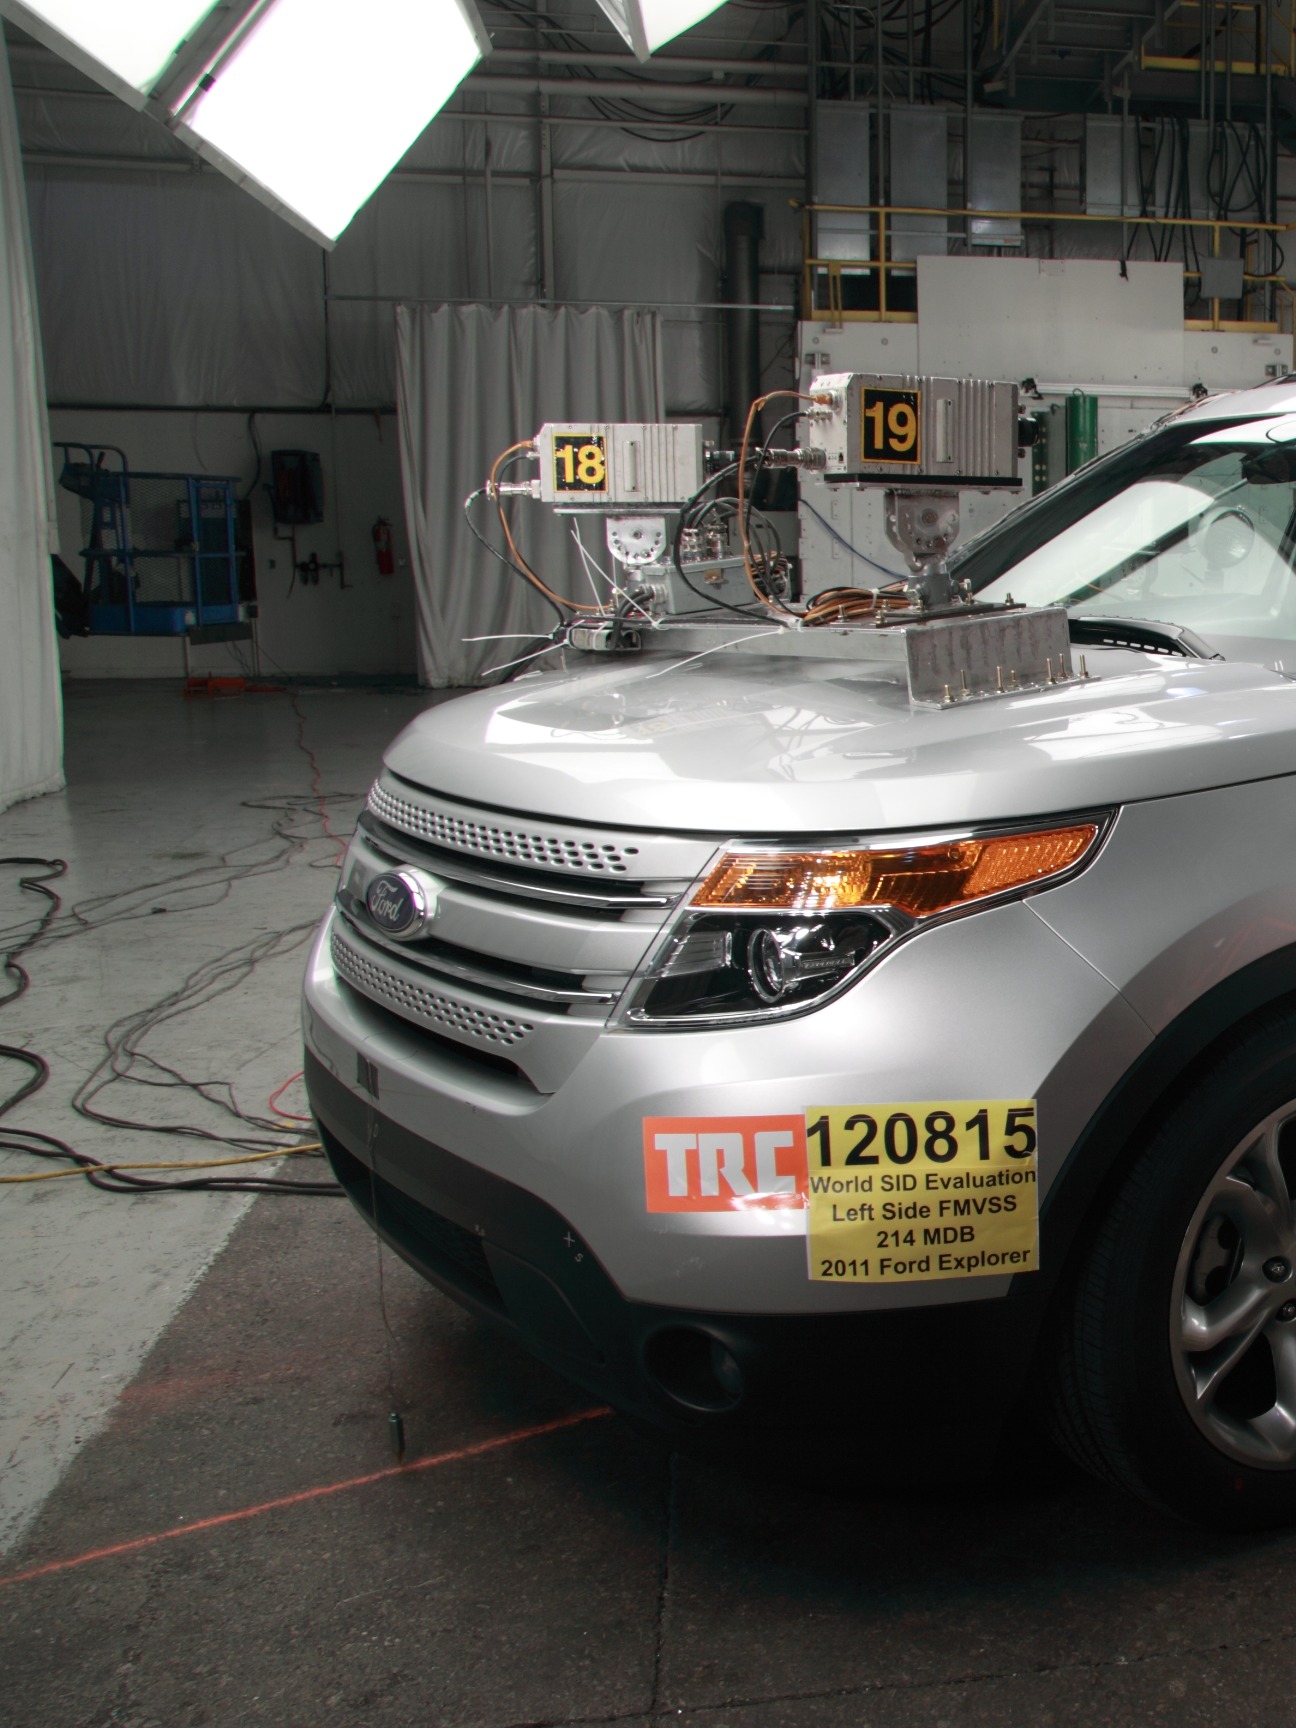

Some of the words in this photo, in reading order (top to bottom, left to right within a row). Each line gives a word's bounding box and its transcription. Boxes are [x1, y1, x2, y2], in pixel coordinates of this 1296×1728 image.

[864, 401, 917, 452] 19
[556, 444, 605, 484] 18
[371, 880, 404, 922] Ford
[807, 1108, 1037, 1168] 120815
[654, 1131, 797, 1198] TRC
[811, 1175, 873, 1194] World
[881, 1174, 917, 1192] SID
[925, 1169, 1036, 1191] Evaluation
[832, 1204, 875, 1222] Left
[882, 1202, 931, 1221] Side
[939, 1195, 1017, 1217] FMVSS
[877, 1230, 916, 1249] 214
[923, 1226, 975, 1245] MDB
[821, 1259, 870, 1277] 2011
[879, 1256, 931, 1276] Ford
[938, 1250, 1031, 1272] Explorer
